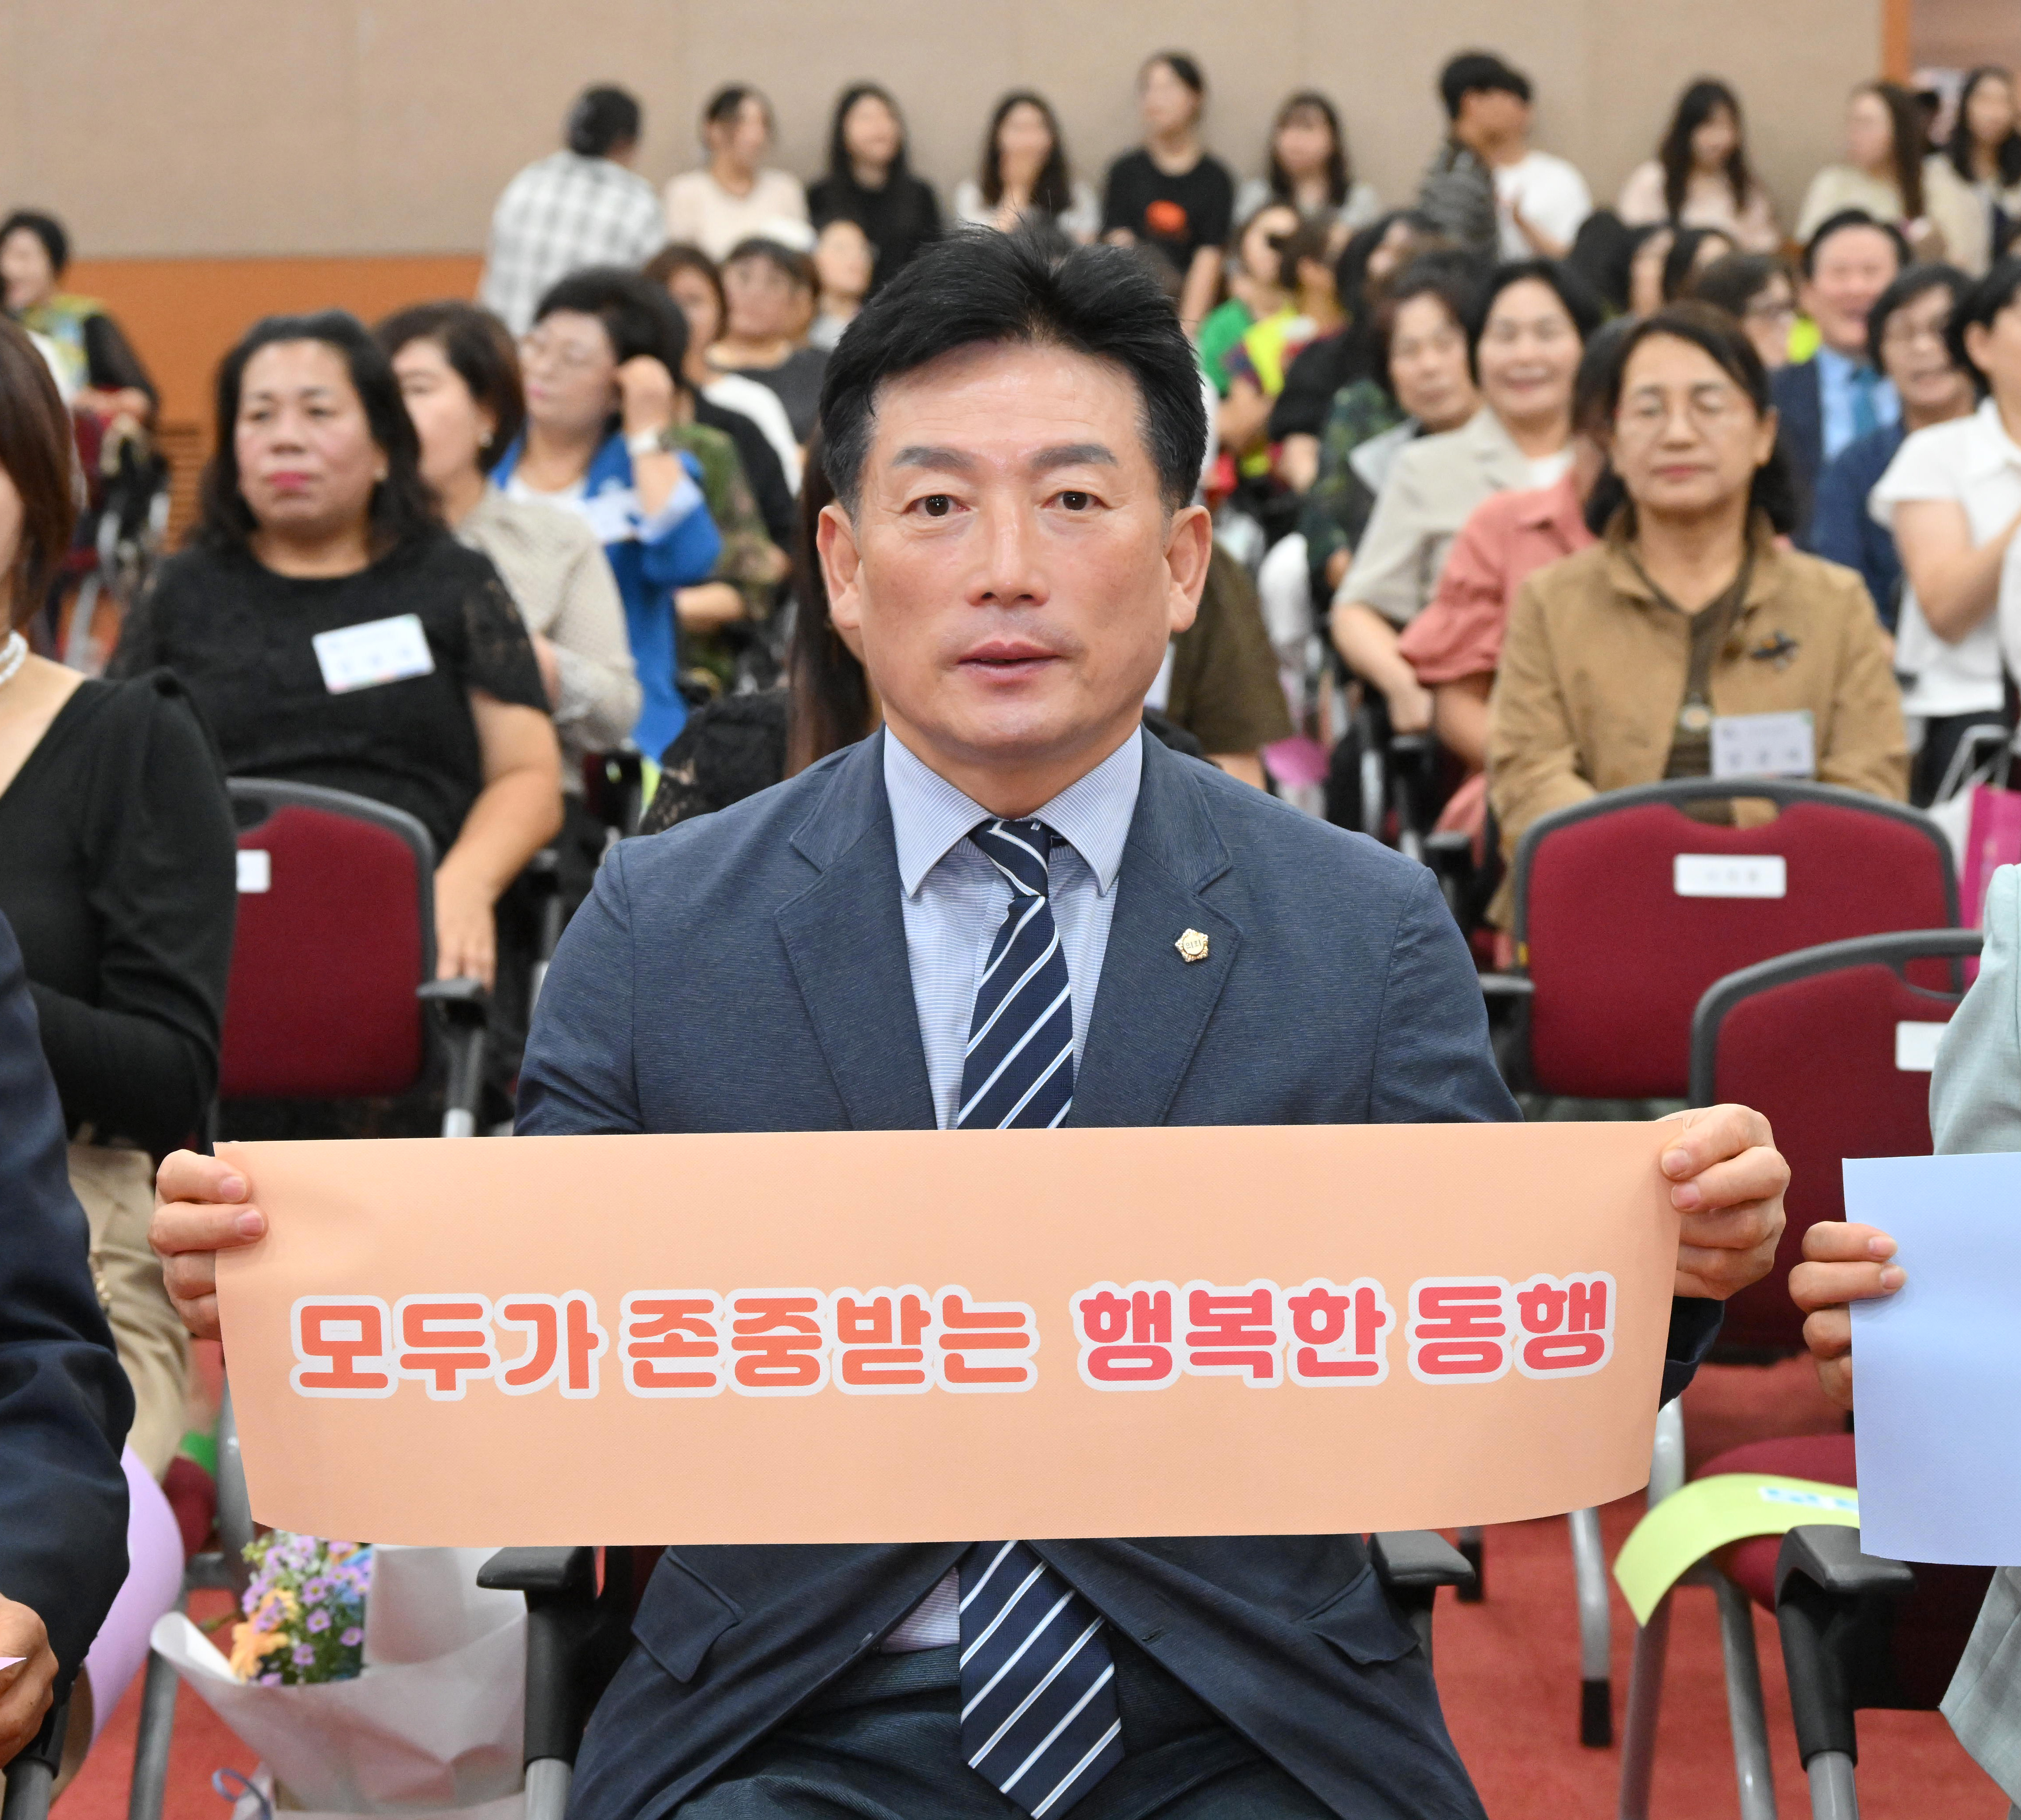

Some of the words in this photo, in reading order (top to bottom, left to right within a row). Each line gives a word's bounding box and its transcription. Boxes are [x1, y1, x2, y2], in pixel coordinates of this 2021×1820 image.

[299, 1299, 599, 1391] 모두가
[628, 1294, 1030, 1389] 존중받는
[1079, 1287, 1386, 1381] 행복한
[1415, 1280, 1607, 1375] 동행
